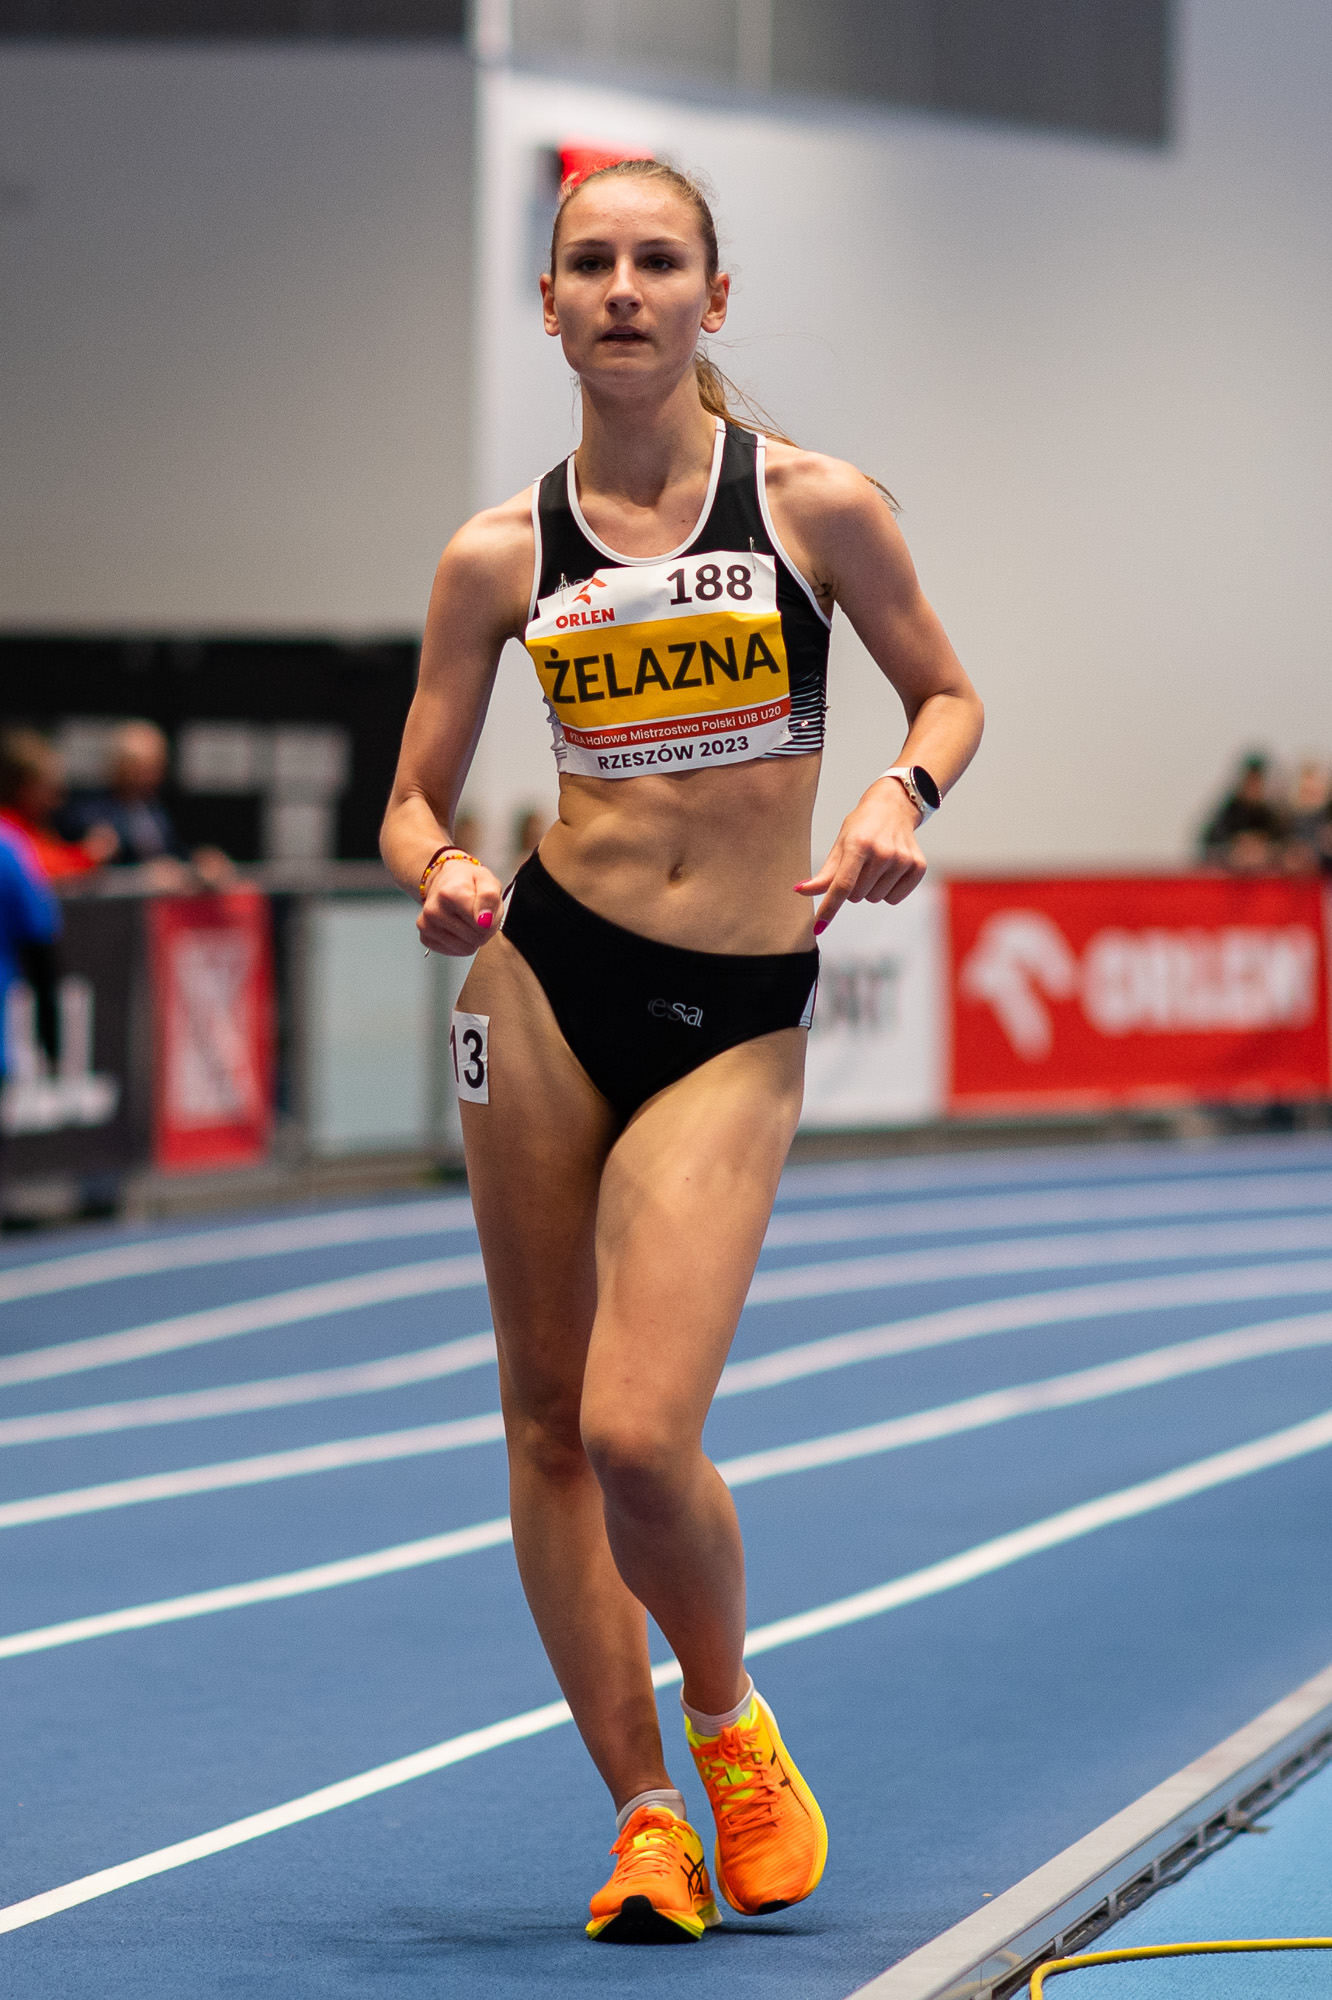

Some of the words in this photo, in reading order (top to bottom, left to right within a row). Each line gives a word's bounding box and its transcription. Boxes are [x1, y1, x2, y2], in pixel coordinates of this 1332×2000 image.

[666, 563, 753, 605] 188
[555, 607, 616, 629] ORLEN
[544, 631, 781, 705] ŻELAZNA
[586, 733, 628, 746] Halowe
[629, 723, 700, 741] Mistrzostwa
[701, 715, 736, 731] Polski
[738, 711, 759, 726] U18
[760, 705, 782, 720] U20
[597, 743, 694, 771] RZESZÓW
[699, 735, 750, 758] 2023
[451, 1024, 486, 1089] 13
